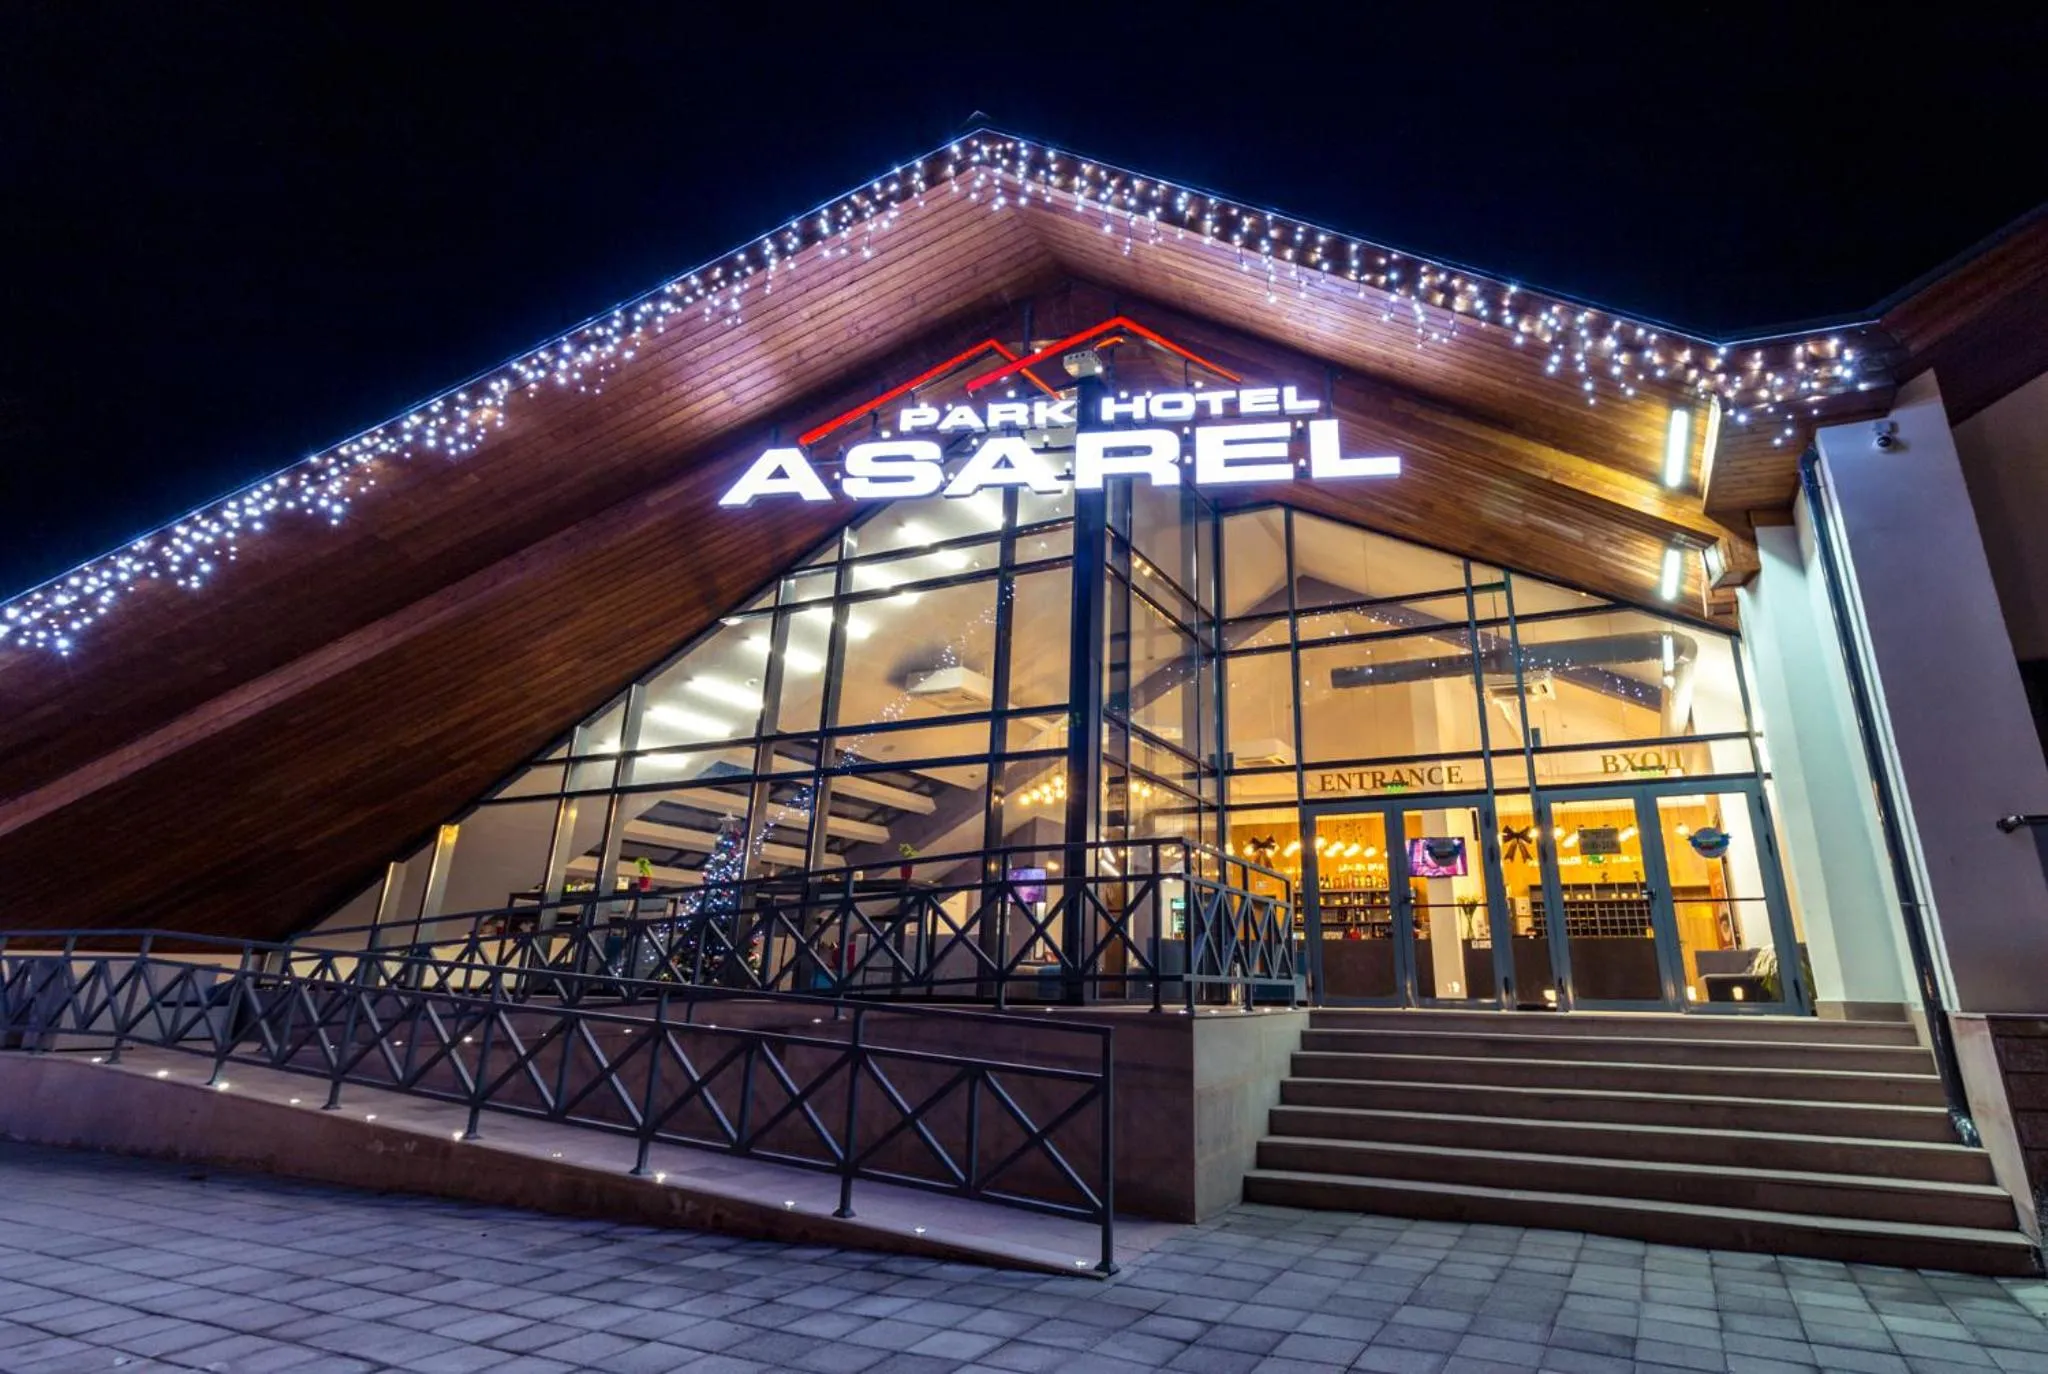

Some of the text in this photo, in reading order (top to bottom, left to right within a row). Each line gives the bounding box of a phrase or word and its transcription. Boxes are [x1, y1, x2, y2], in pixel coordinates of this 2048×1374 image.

[899, 386, 1320, 432] PARK HOTEL
[718, 419, 1402, 507] ASAREL
[1320, 766, 1463, 792] ENTRANCE
[1601, 749, 1685, 774] ВХОД
